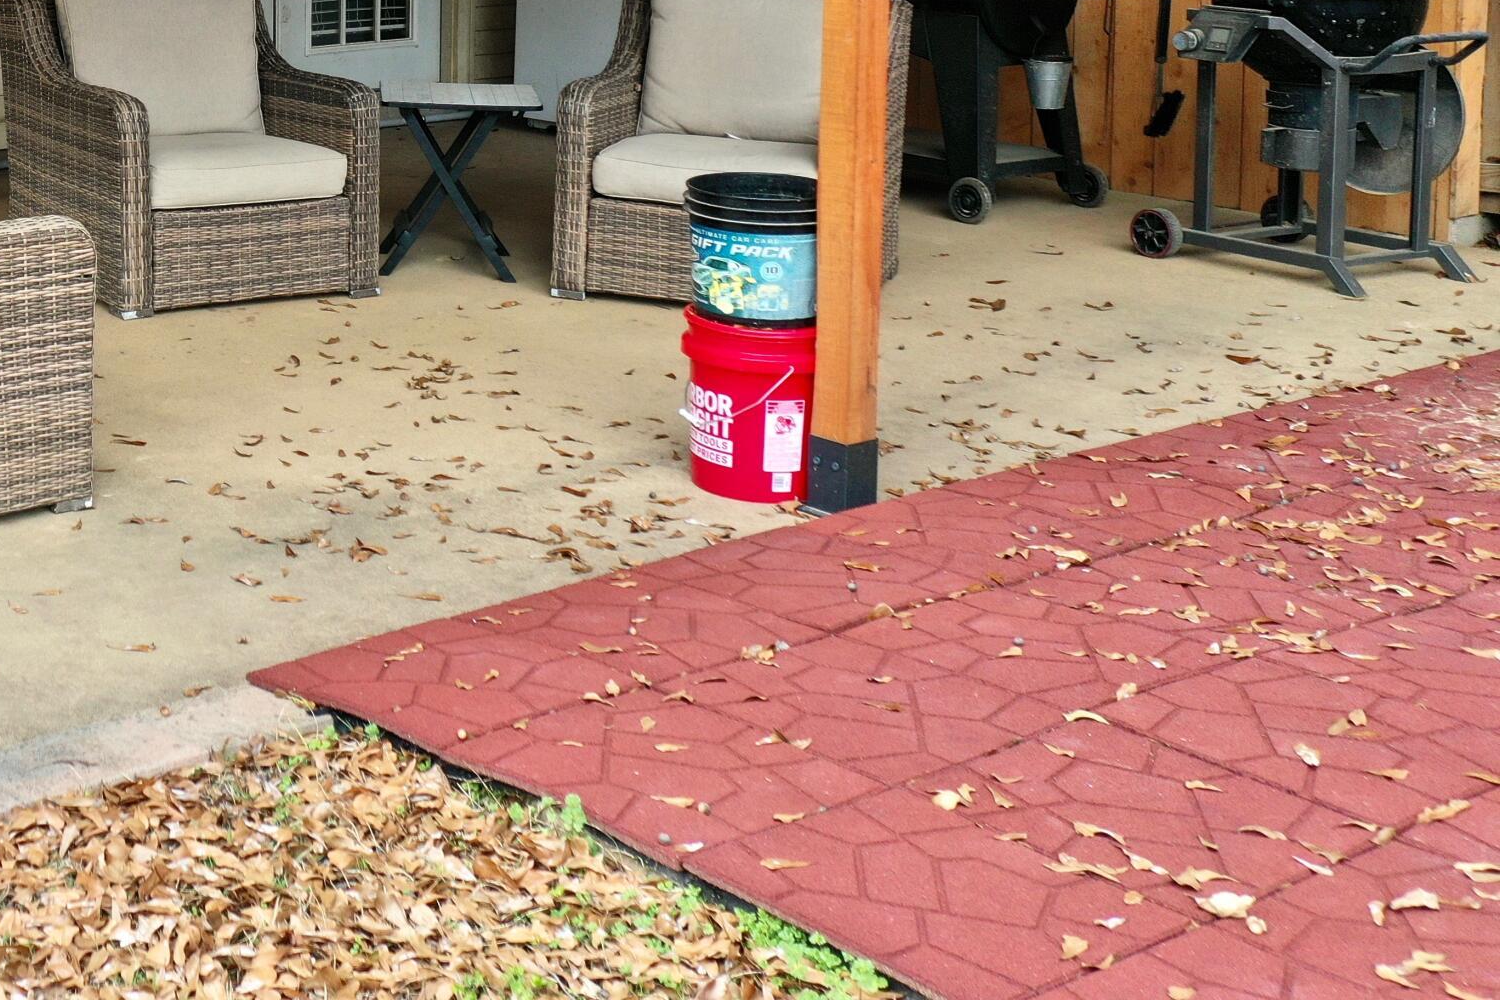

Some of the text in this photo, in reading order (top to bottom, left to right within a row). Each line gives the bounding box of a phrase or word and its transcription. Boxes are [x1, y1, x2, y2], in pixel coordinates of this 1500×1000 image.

[691, 233, 795, 263] GIFT PACK
[731, 235, 750, 243] CAR
[699, 433, 728, 450] TOOLS
[697, 446, 728, 465] PRICES
